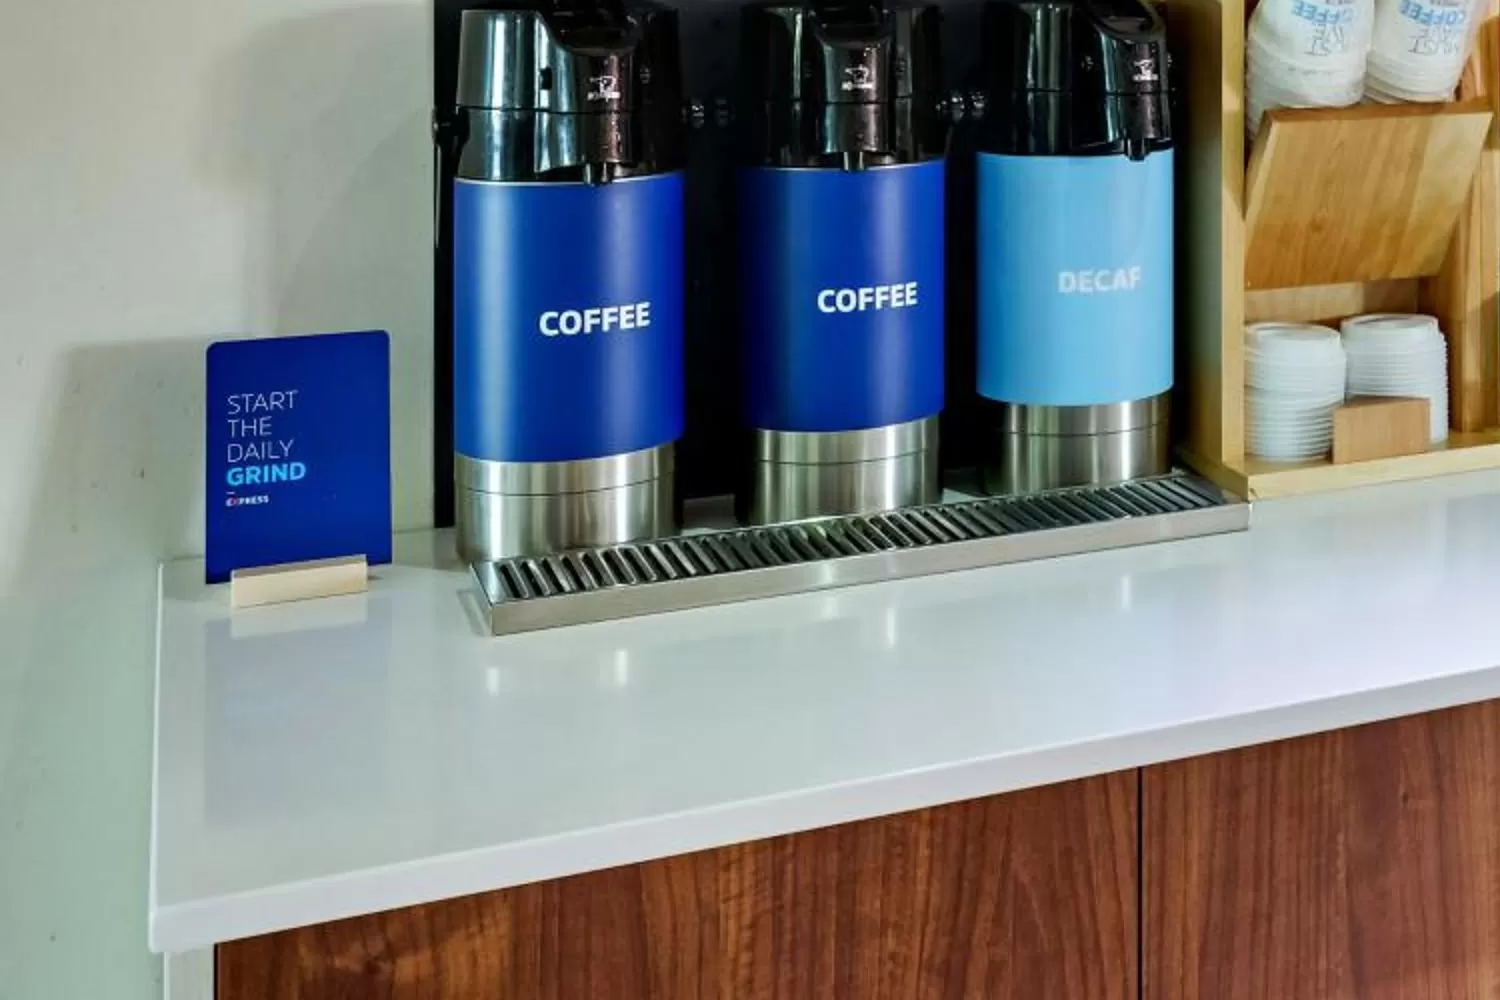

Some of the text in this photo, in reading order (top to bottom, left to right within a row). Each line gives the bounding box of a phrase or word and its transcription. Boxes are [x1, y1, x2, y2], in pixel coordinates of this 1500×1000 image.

[1058, 265, 1142, 294] DECAF
[816, 281, 918, 314] COFFEE
[538, 301, 652, 338] COFFEE
[227, 389, 298, 415] START
[227, 416, 272, 438] THE
[227, 439, 294, 462] DAILY
[226, 461, 307, 487] GRIND
